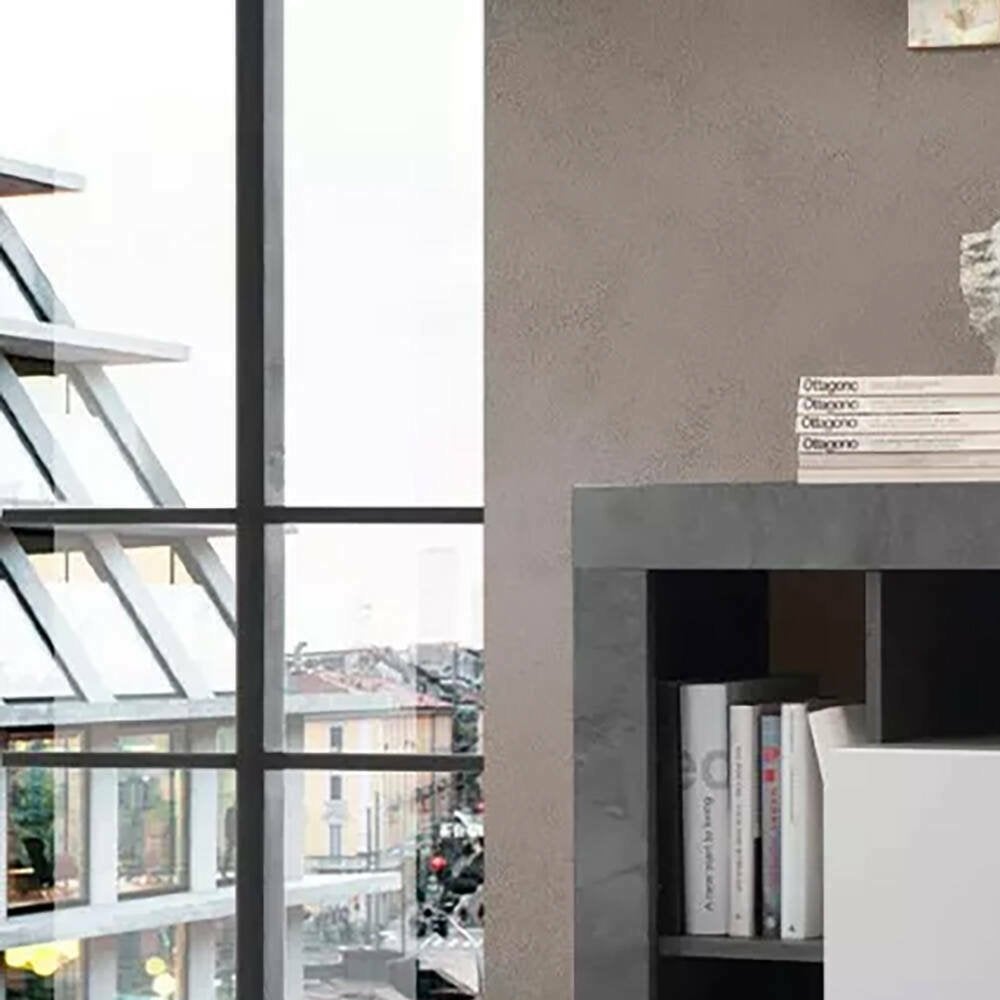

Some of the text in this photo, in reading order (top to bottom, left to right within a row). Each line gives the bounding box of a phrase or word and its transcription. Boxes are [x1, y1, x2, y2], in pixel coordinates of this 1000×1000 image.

[803, 379, 859, 393] Ottagono
[804, 397, 860, 413] Ottagono
[801, 415, 858, 431] Ottagono
[802, 437, 859, 453] Ottagono
